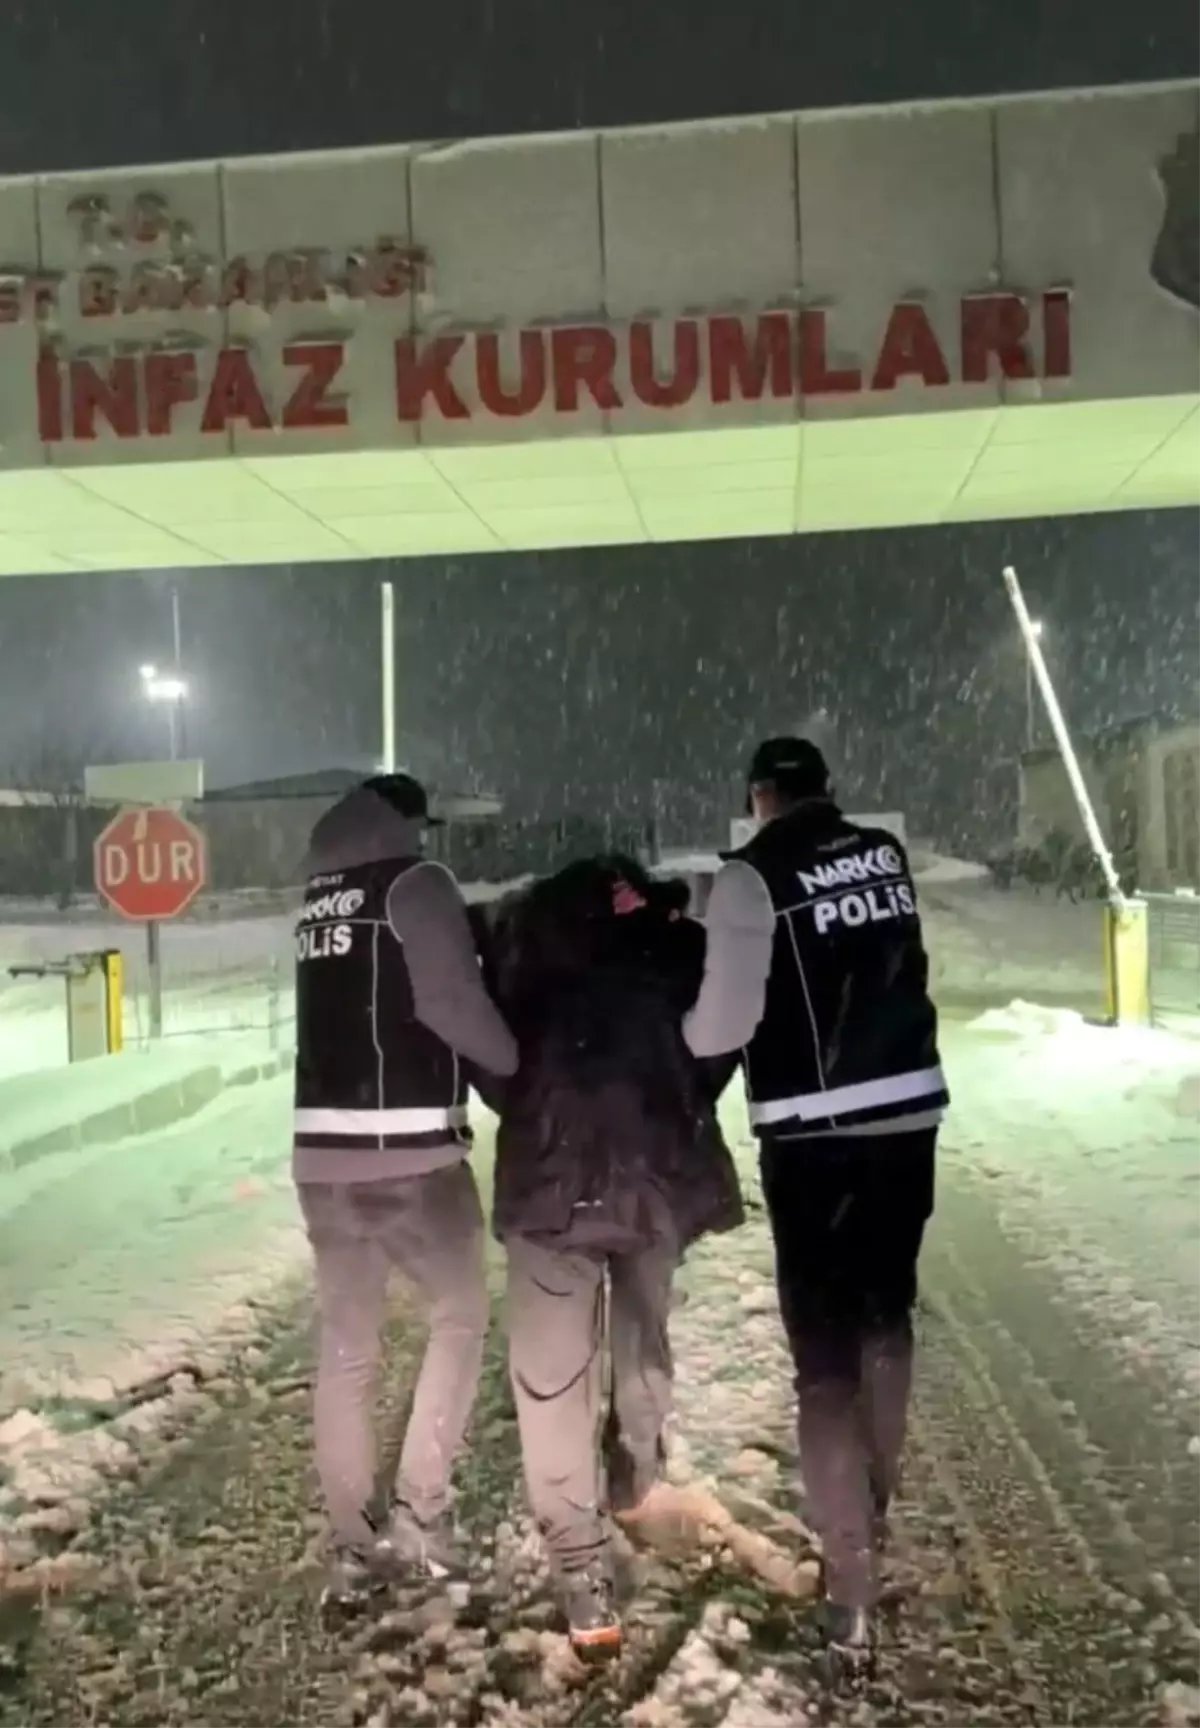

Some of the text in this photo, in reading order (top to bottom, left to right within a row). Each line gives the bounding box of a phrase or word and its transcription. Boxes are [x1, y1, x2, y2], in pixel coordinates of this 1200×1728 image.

[36, 290, 1071, 441] İNFAZ KURUMLARI
[105, 841, 194, 886] DUR
[796, 845, 902, 895] NARKO
